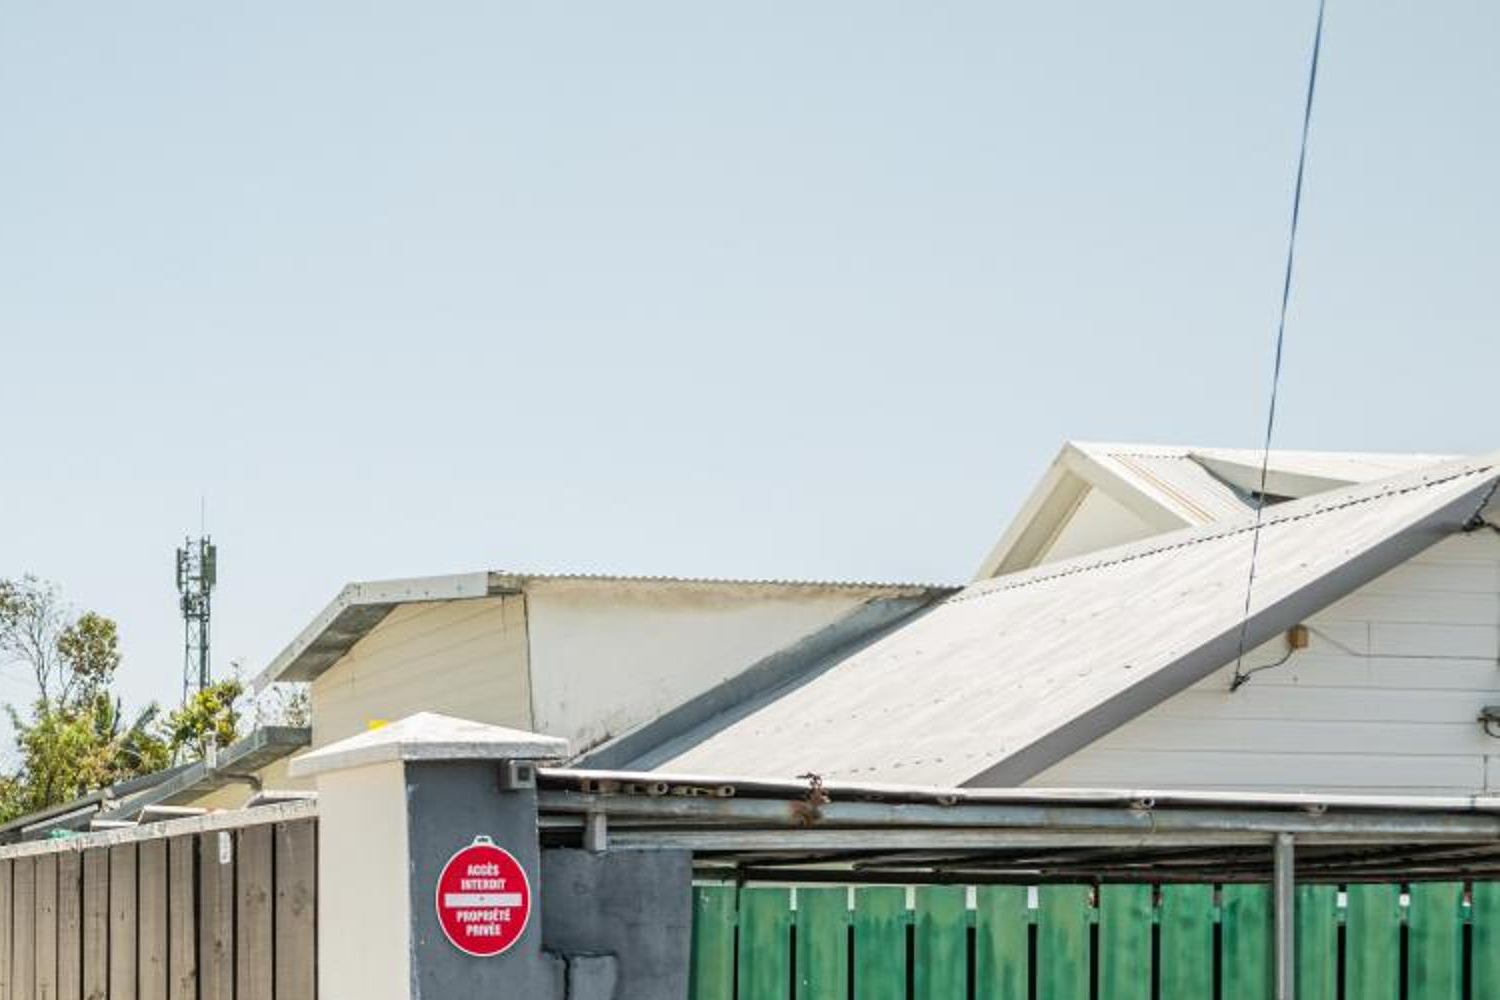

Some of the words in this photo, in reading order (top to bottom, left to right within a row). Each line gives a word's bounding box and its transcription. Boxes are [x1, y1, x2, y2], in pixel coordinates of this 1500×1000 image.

[467, 861, 500, 876] ACCÈS
[461, 878, 506, 891] INTERDIT
[456, 908, 511, 922] PROPRIÉTÉ
[466, 922, 501, 937] PRIVÉE
